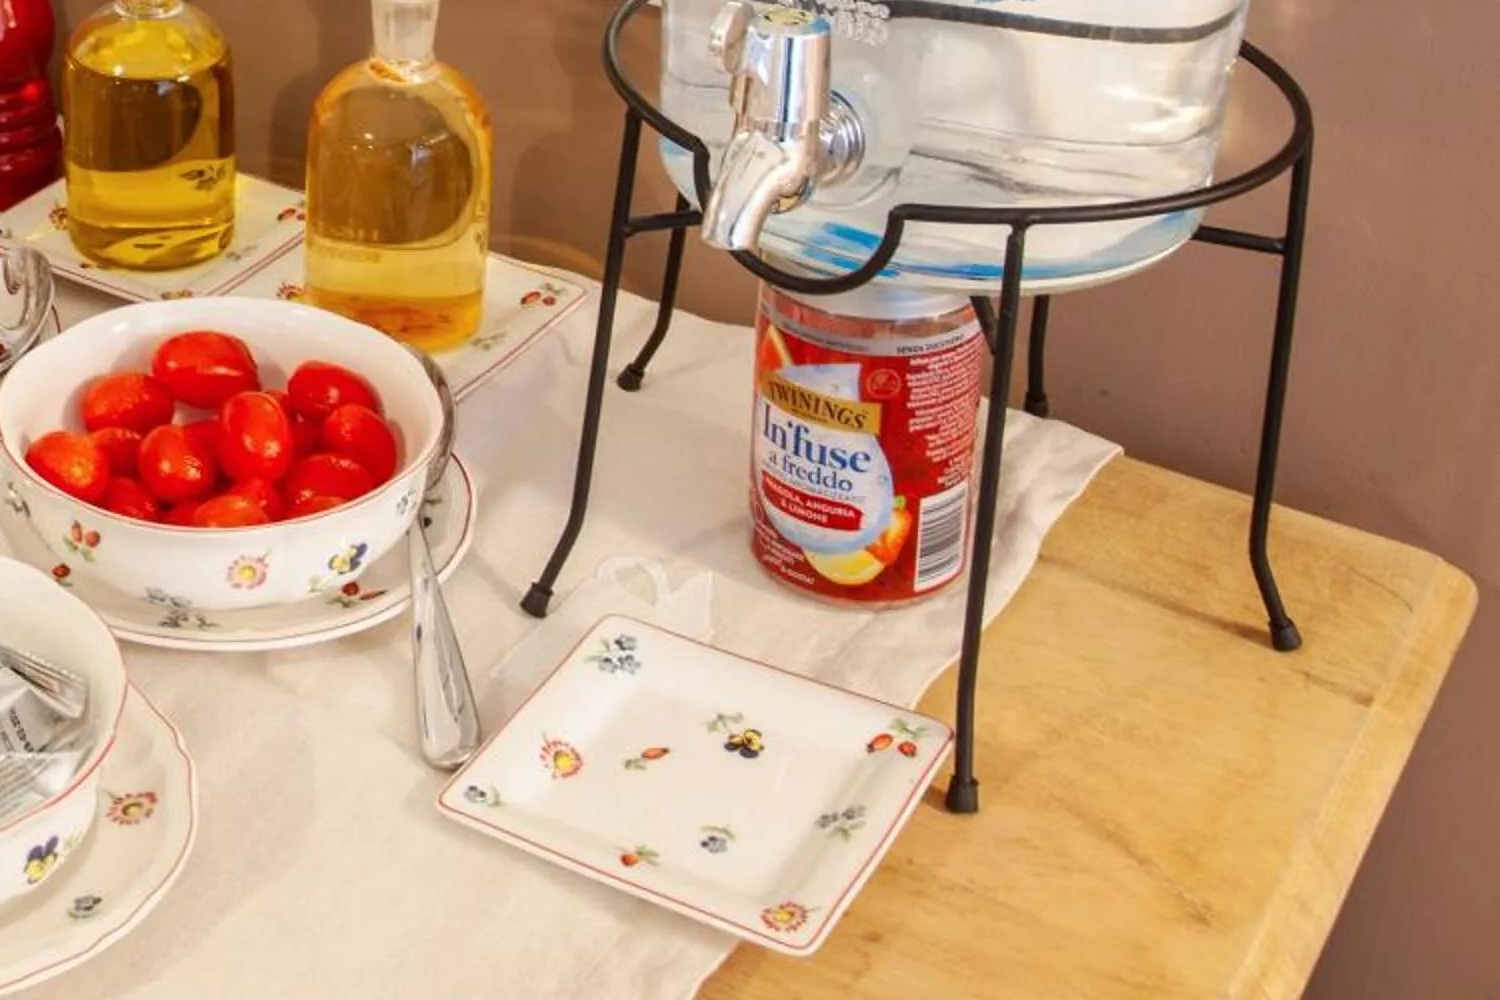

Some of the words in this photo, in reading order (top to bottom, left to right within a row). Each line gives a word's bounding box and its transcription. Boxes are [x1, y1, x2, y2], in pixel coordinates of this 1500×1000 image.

[768, 381, 868, 429] TWININGS
[782, 454, 854, 492] freddo
[805, 499, 856, 518] ANGURIA
